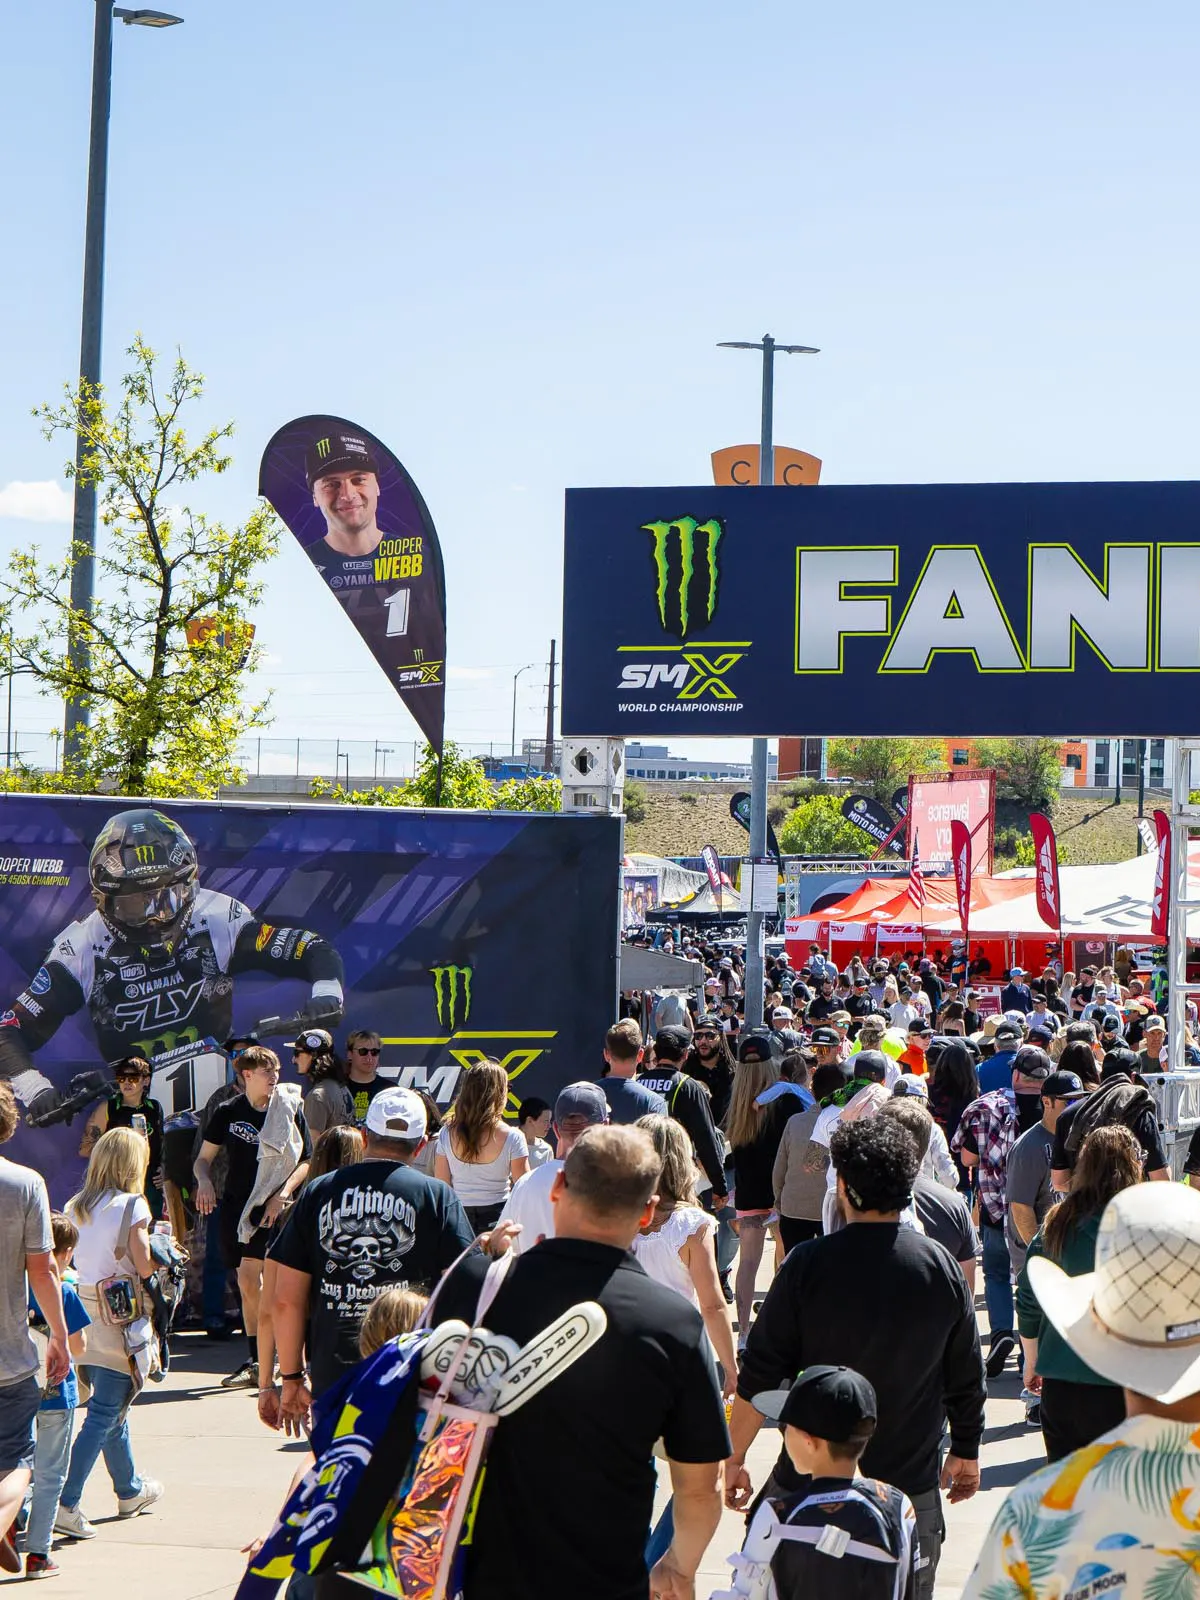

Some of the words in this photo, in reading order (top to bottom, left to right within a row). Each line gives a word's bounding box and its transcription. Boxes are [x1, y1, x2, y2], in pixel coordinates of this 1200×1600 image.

[731, 461, 750, 485] C
[783, 464, 803, 486] C
[379, 537, 422, 556] COOPER
[374, 554, 423, 581] WEBB
[344, 574, 376, 587] YAMA
[384, 588, 410, 637] 1
[399, 665, 440, 683] SMX
[617, 653, 743, 698] SMX
[618, 703, 656, 712] WORLD
[659, 703, 743, 712] CHAMPIONSHIP
[848, 811, 869, 829] MOTO
[867, 824, 889, 842] RAISE
[32, 858, 64, 873] WEBB
[8, 874, 30, 885] 450SX
[32, 875, 71, 887] CHAMPION
[122, 965, 143, 977] 100%
[138, 971, 185, 995] YAMAHA
[166, 1059, 196, 1113] 1
[320, 1199, 333, 1240] El
[341, 1185, 415, 1233] Chingon
[508, 1327, 577, 1385] BRAAAP
[1093, 1573, 1127, 1594] MOON
